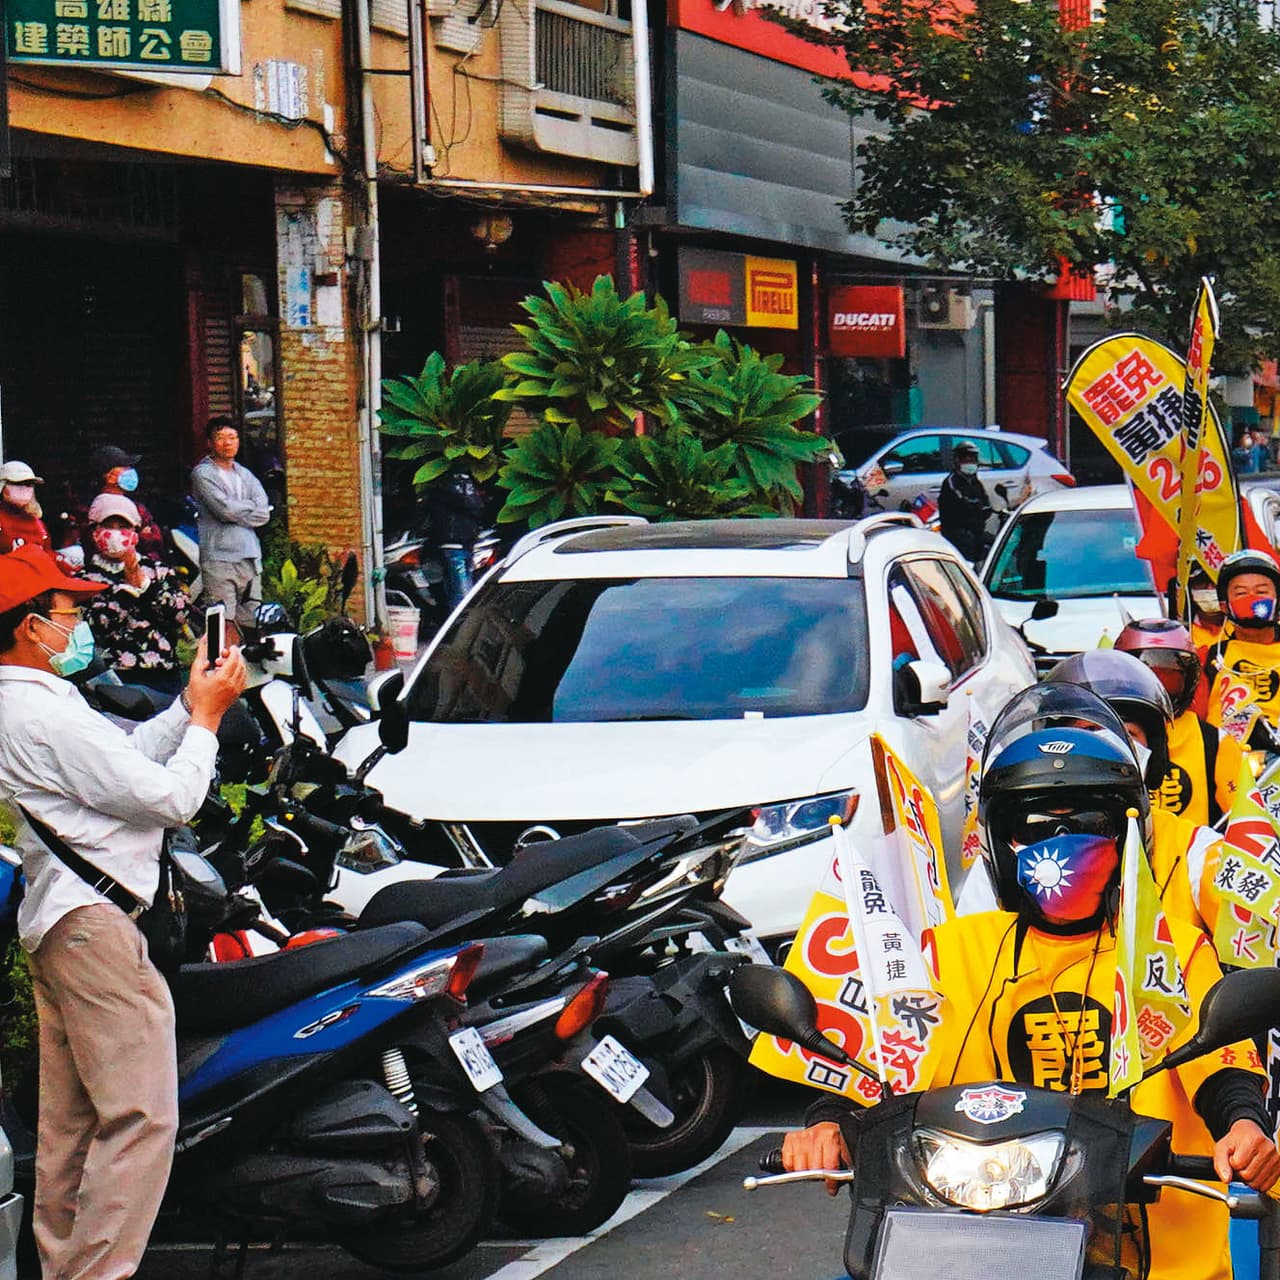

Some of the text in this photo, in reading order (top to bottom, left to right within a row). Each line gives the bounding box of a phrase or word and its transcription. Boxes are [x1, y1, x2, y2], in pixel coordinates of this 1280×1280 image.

[14, 22, 213, 62] 建築師公會
[833, 312, 896, 326] DUCATI
[1083, 349, 1165, 425] 罷免
[880, 931, 908, 982] 黃捷
[1025, 1013, 1107, 1090] 罷
